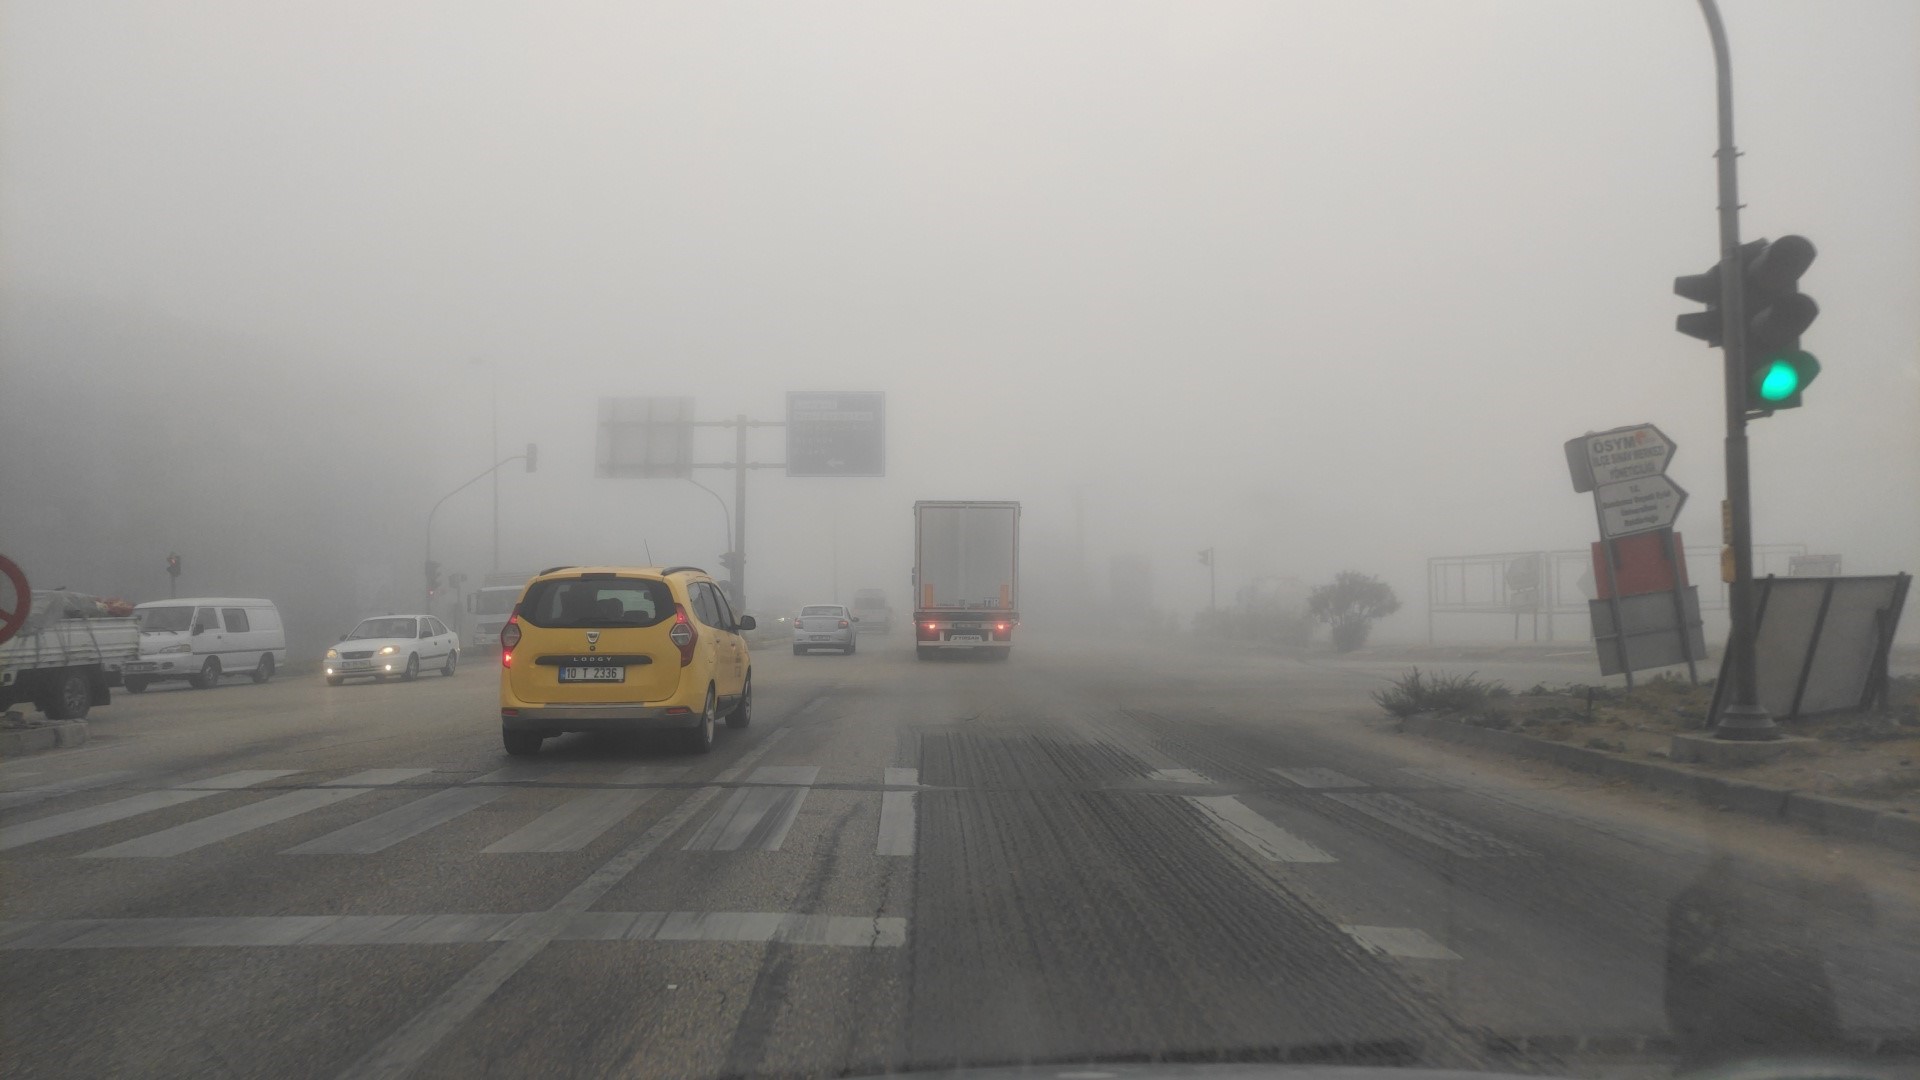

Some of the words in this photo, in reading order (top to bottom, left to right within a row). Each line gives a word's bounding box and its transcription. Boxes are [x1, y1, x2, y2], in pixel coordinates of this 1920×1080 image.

[1593, 434, 1636, 453] ÖSYM
[566, 668, 577, 678] 10
[583, 668, 589, 678] T
[593, 667, 617, 678] 2336
